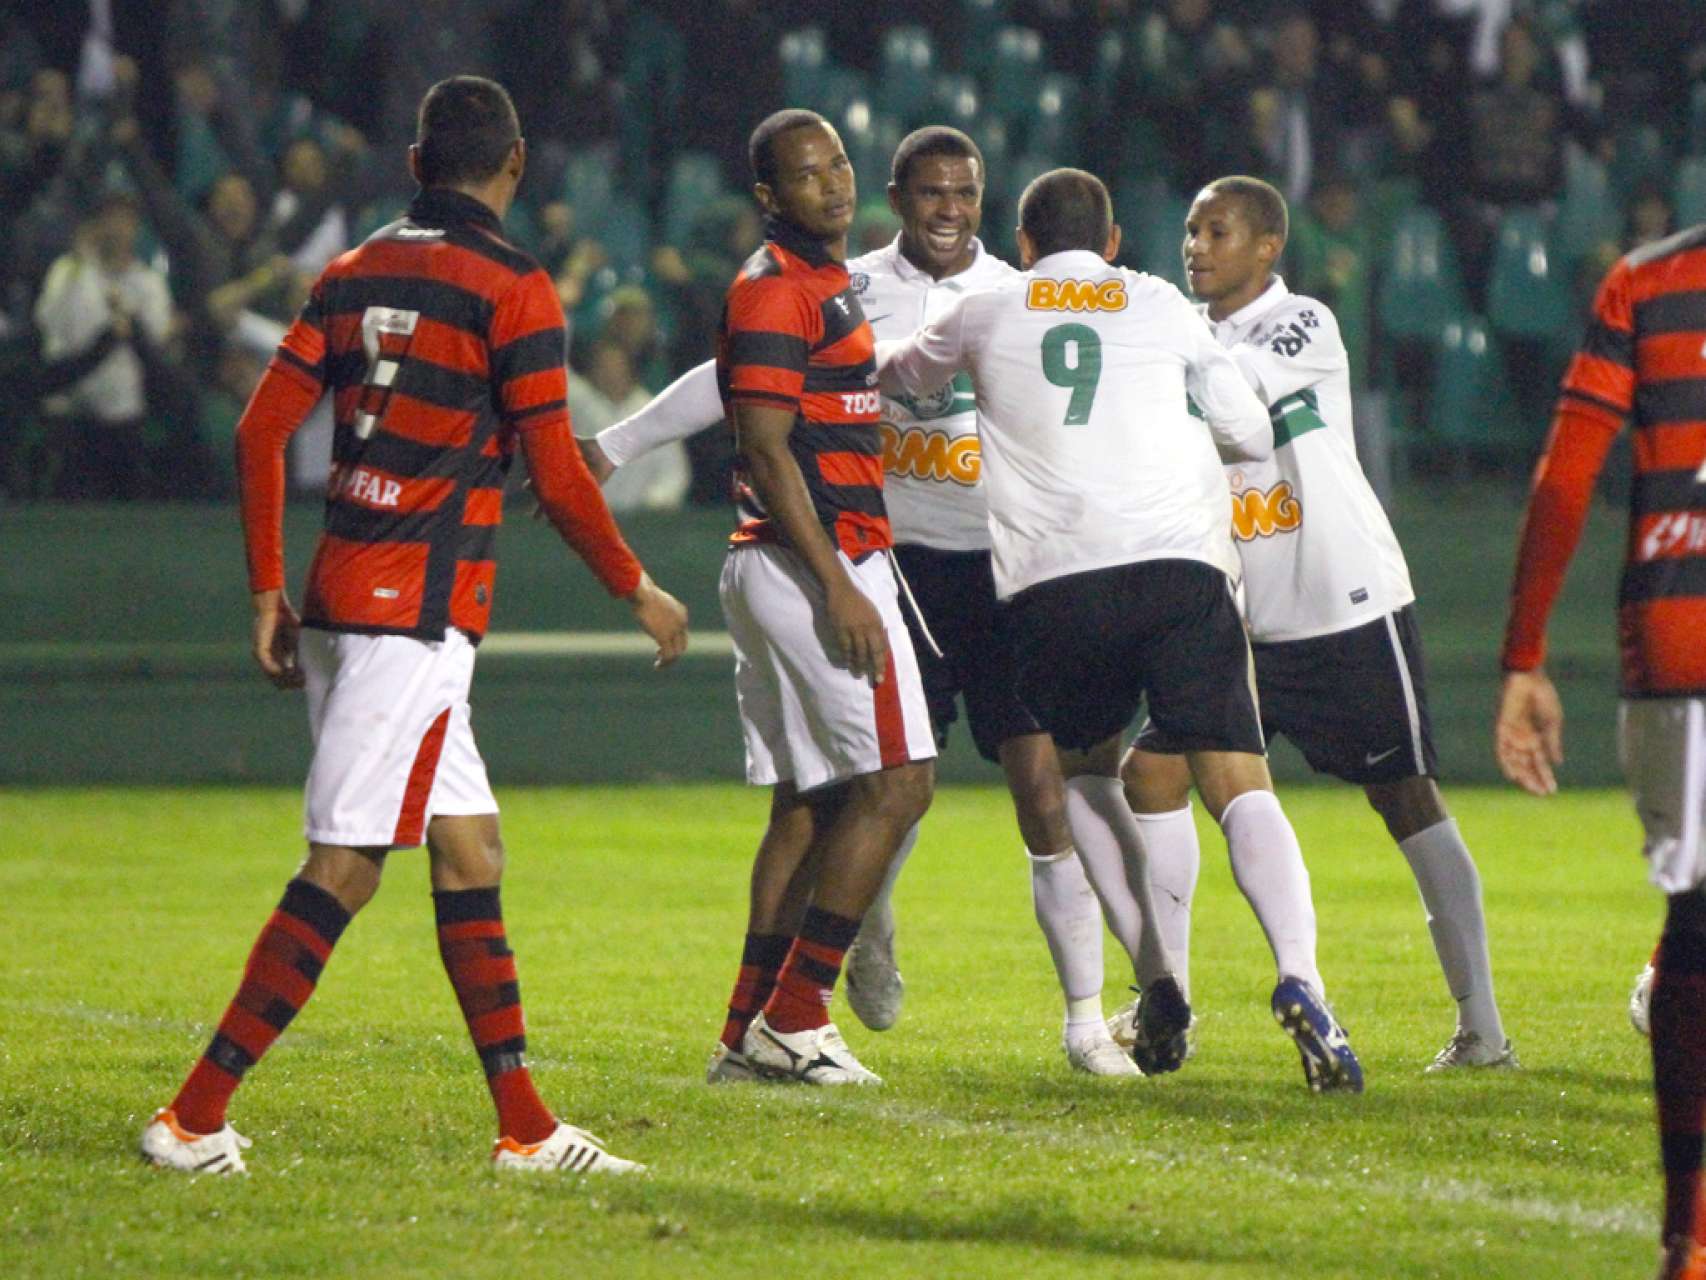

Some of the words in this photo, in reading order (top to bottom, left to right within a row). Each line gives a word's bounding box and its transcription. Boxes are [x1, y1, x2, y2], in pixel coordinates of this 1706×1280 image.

[1027, 278, 1128, 312] BMG
[1041, 322, 1102, 426] 9
[1231, 480, 1303, 541] MG
